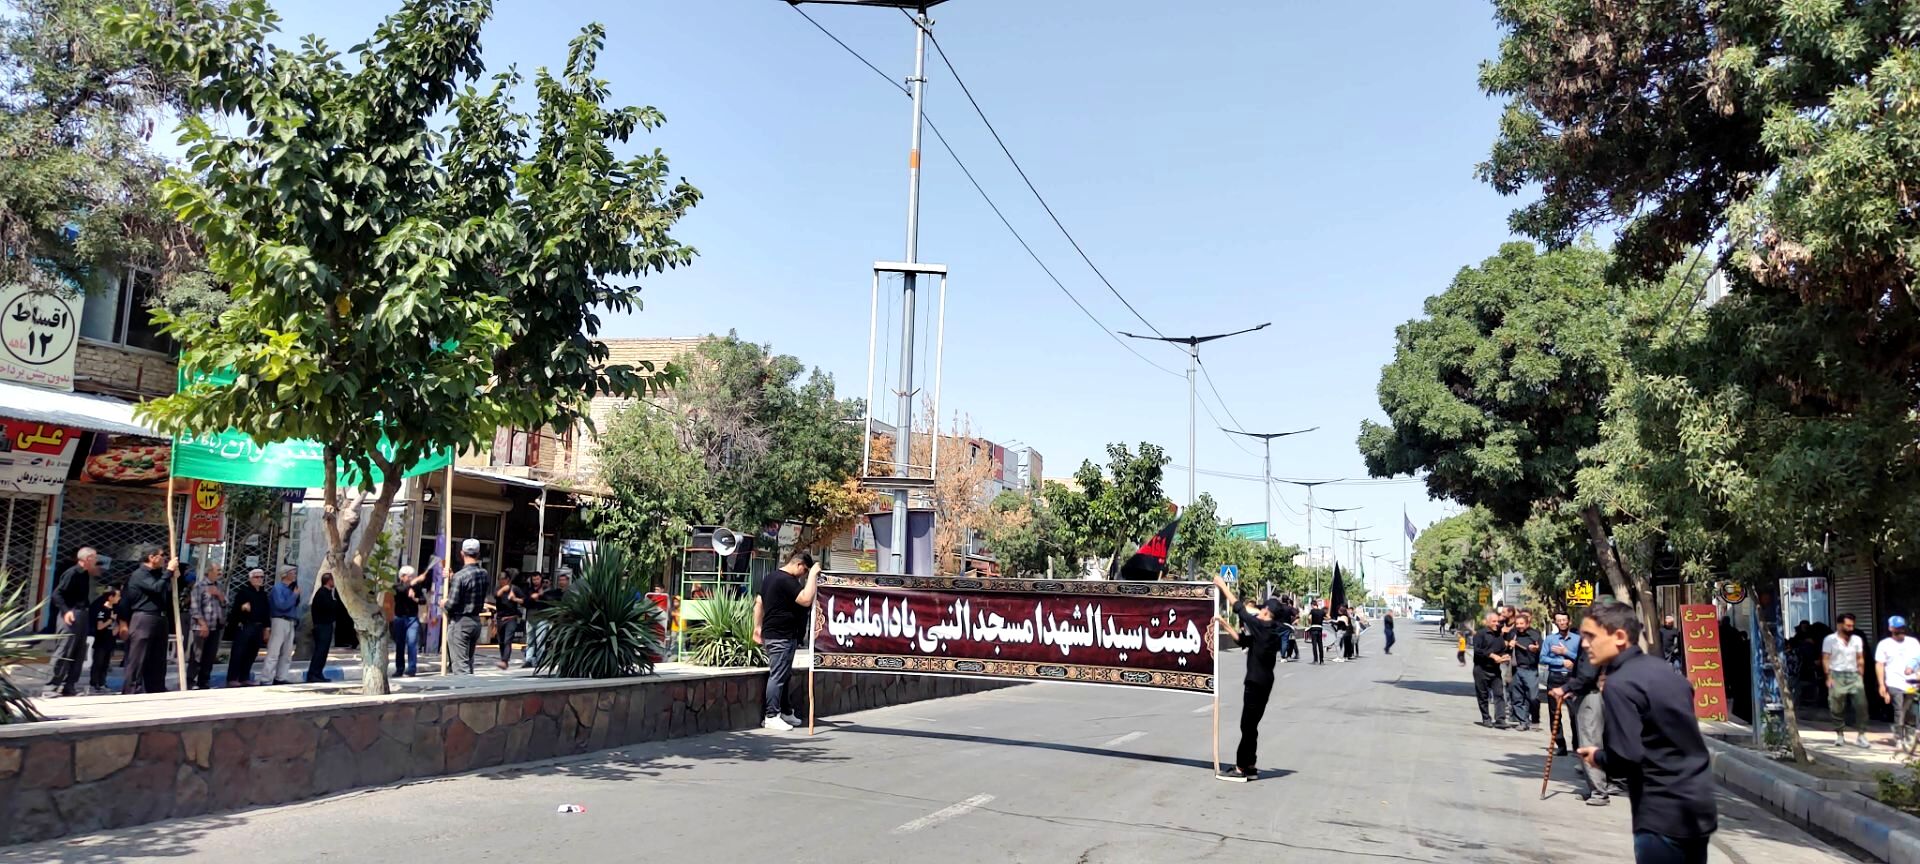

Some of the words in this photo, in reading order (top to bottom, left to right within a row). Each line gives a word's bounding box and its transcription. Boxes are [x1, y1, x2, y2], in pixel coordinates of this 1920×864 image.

[12, 302, 68, 329] اقساط
[28, 331, 54, 357] ۱۲
[17, 424, 64, 449] علی
[918, 597, 972, 654] النبی
[1034, 600, 1102, 656] الشهدا
[1684, 609, 1716, 622] مرغ
[972, 608, 1034, 655] مسجد
[1102, 614, 1144, 662] سید
[1145, 607, 1202, 666] هیئت
[1689, 625, 1714, 639] ران
[1697, 693, 1719, 708] دل
